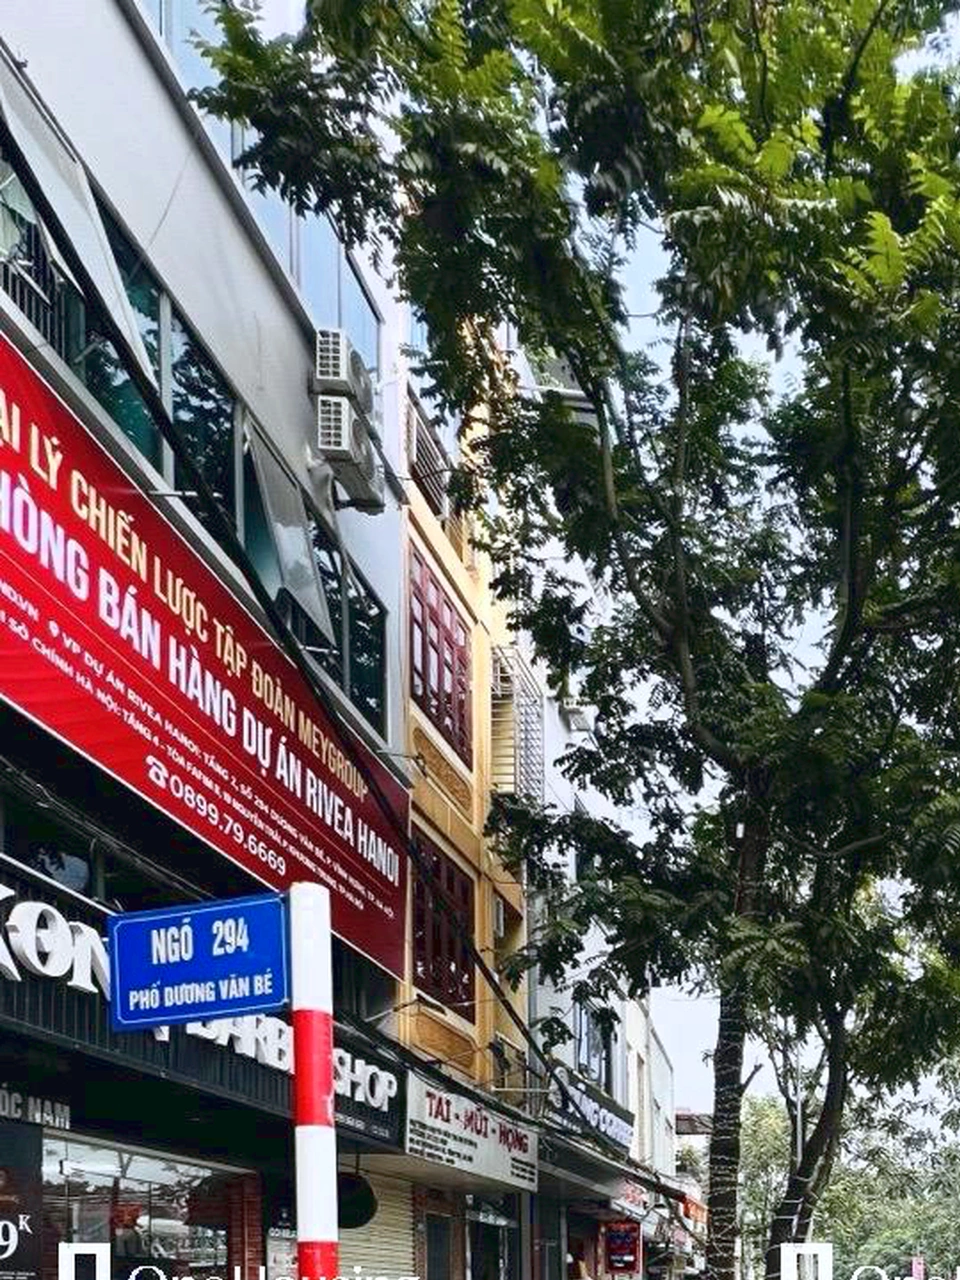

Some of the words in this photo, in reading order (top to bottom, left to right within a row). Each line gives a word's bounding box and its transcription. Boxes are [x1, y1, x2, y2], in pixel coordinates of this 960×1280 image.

[30, 422, 63, 491] LÝ
[71, 469, 147, 583] CHIẾN
[154, 555, 208, 643] LƯỢC
[213, 617, 247, 678] TẬP
[251, 660, 295, 733] ĐOÀN
[299, 709, 368, 803] MEYGROUP
[99, 566, 161, 671] BÁN
[169, 634, 236, 738] HÀNG
[243, 706, 272, 777] DỰ
[276, 735, 301, 798] ÁN
[306, 768, 354, 847] RIVEA
[357, 818, 399, 887] HANOI
[170, 775, 286, 876] 0899.79.6669
[212, 917, 249, 957] 294
[129, 980, 161, 1011] PHỐ
[164, 981, 216, 1008] DƯƠNG
[219, 973, 250, 1000] VĂN
[253, 968, 273, 996] BÉ
[333, 1047, 398, 1113] SHOP
[426, 1090, 452, 1124] TAI
